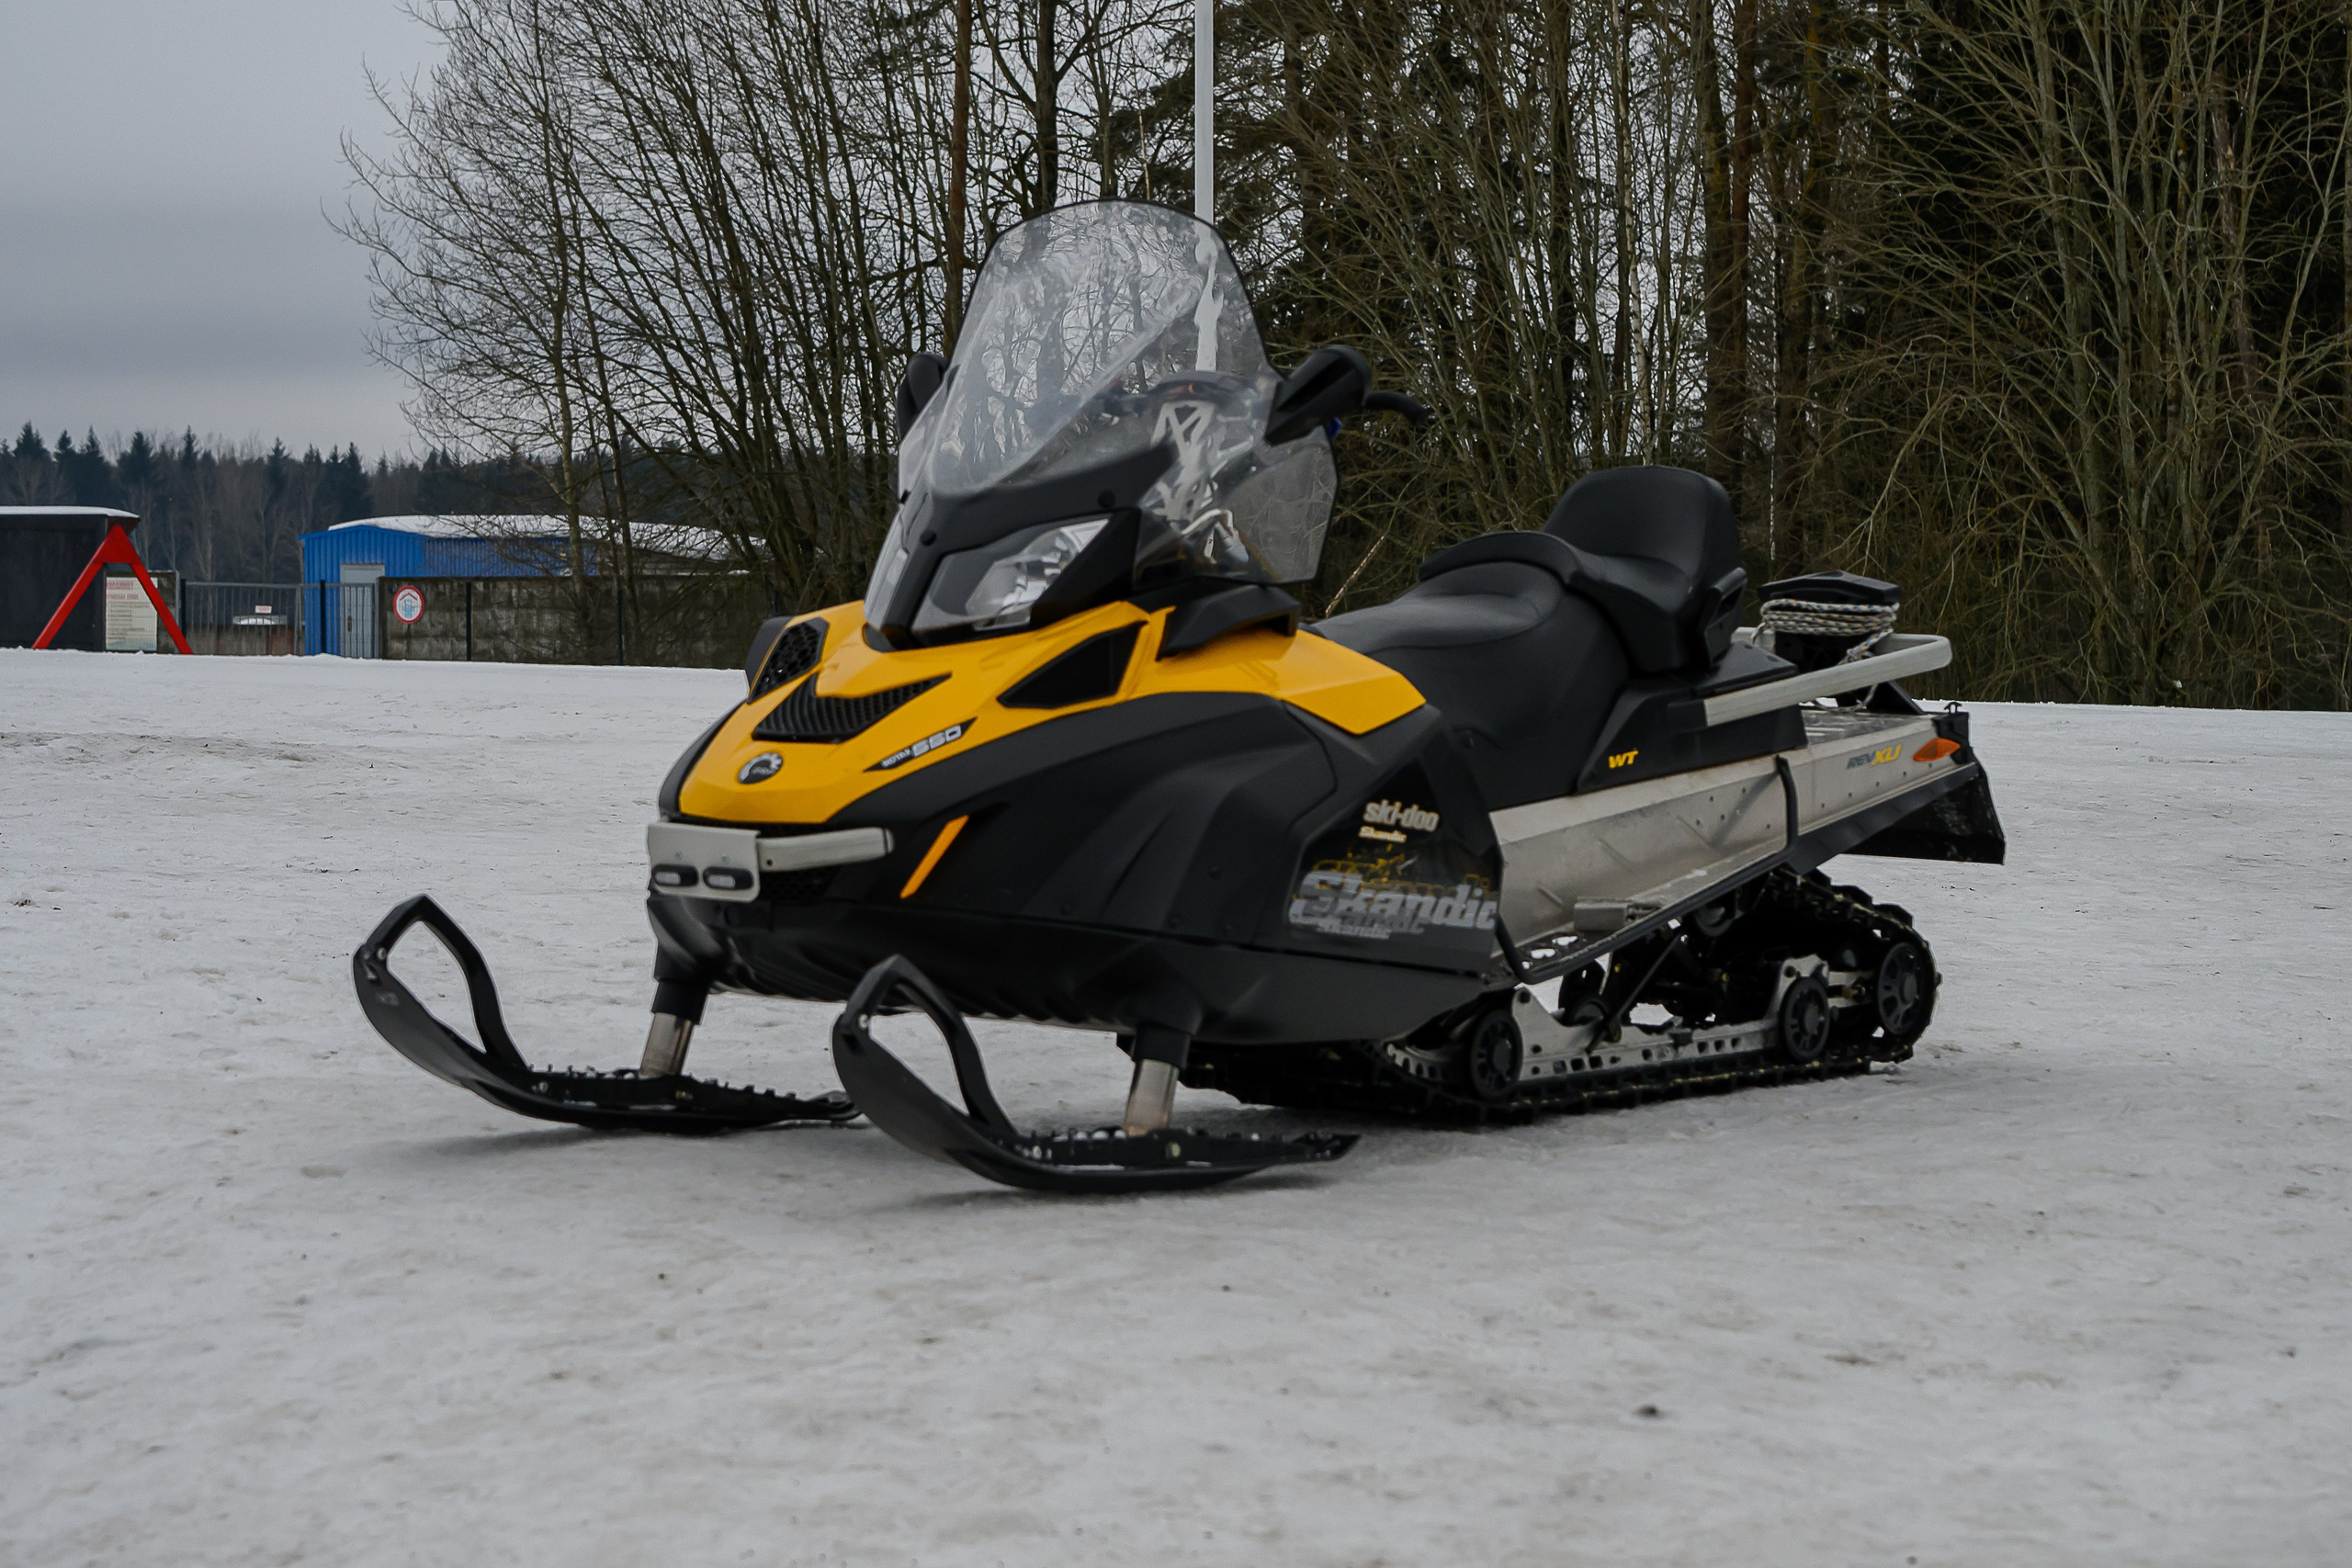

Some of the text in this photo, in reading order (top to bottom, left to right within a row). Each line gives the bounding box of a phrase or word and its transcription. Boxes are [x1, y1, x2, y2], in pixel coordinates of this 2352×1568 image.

[1609, 750, 1639, 768] WT
[1363, 798, 1440, 832] ski-doo
[1288, 870, 1498, 930] Skandic
